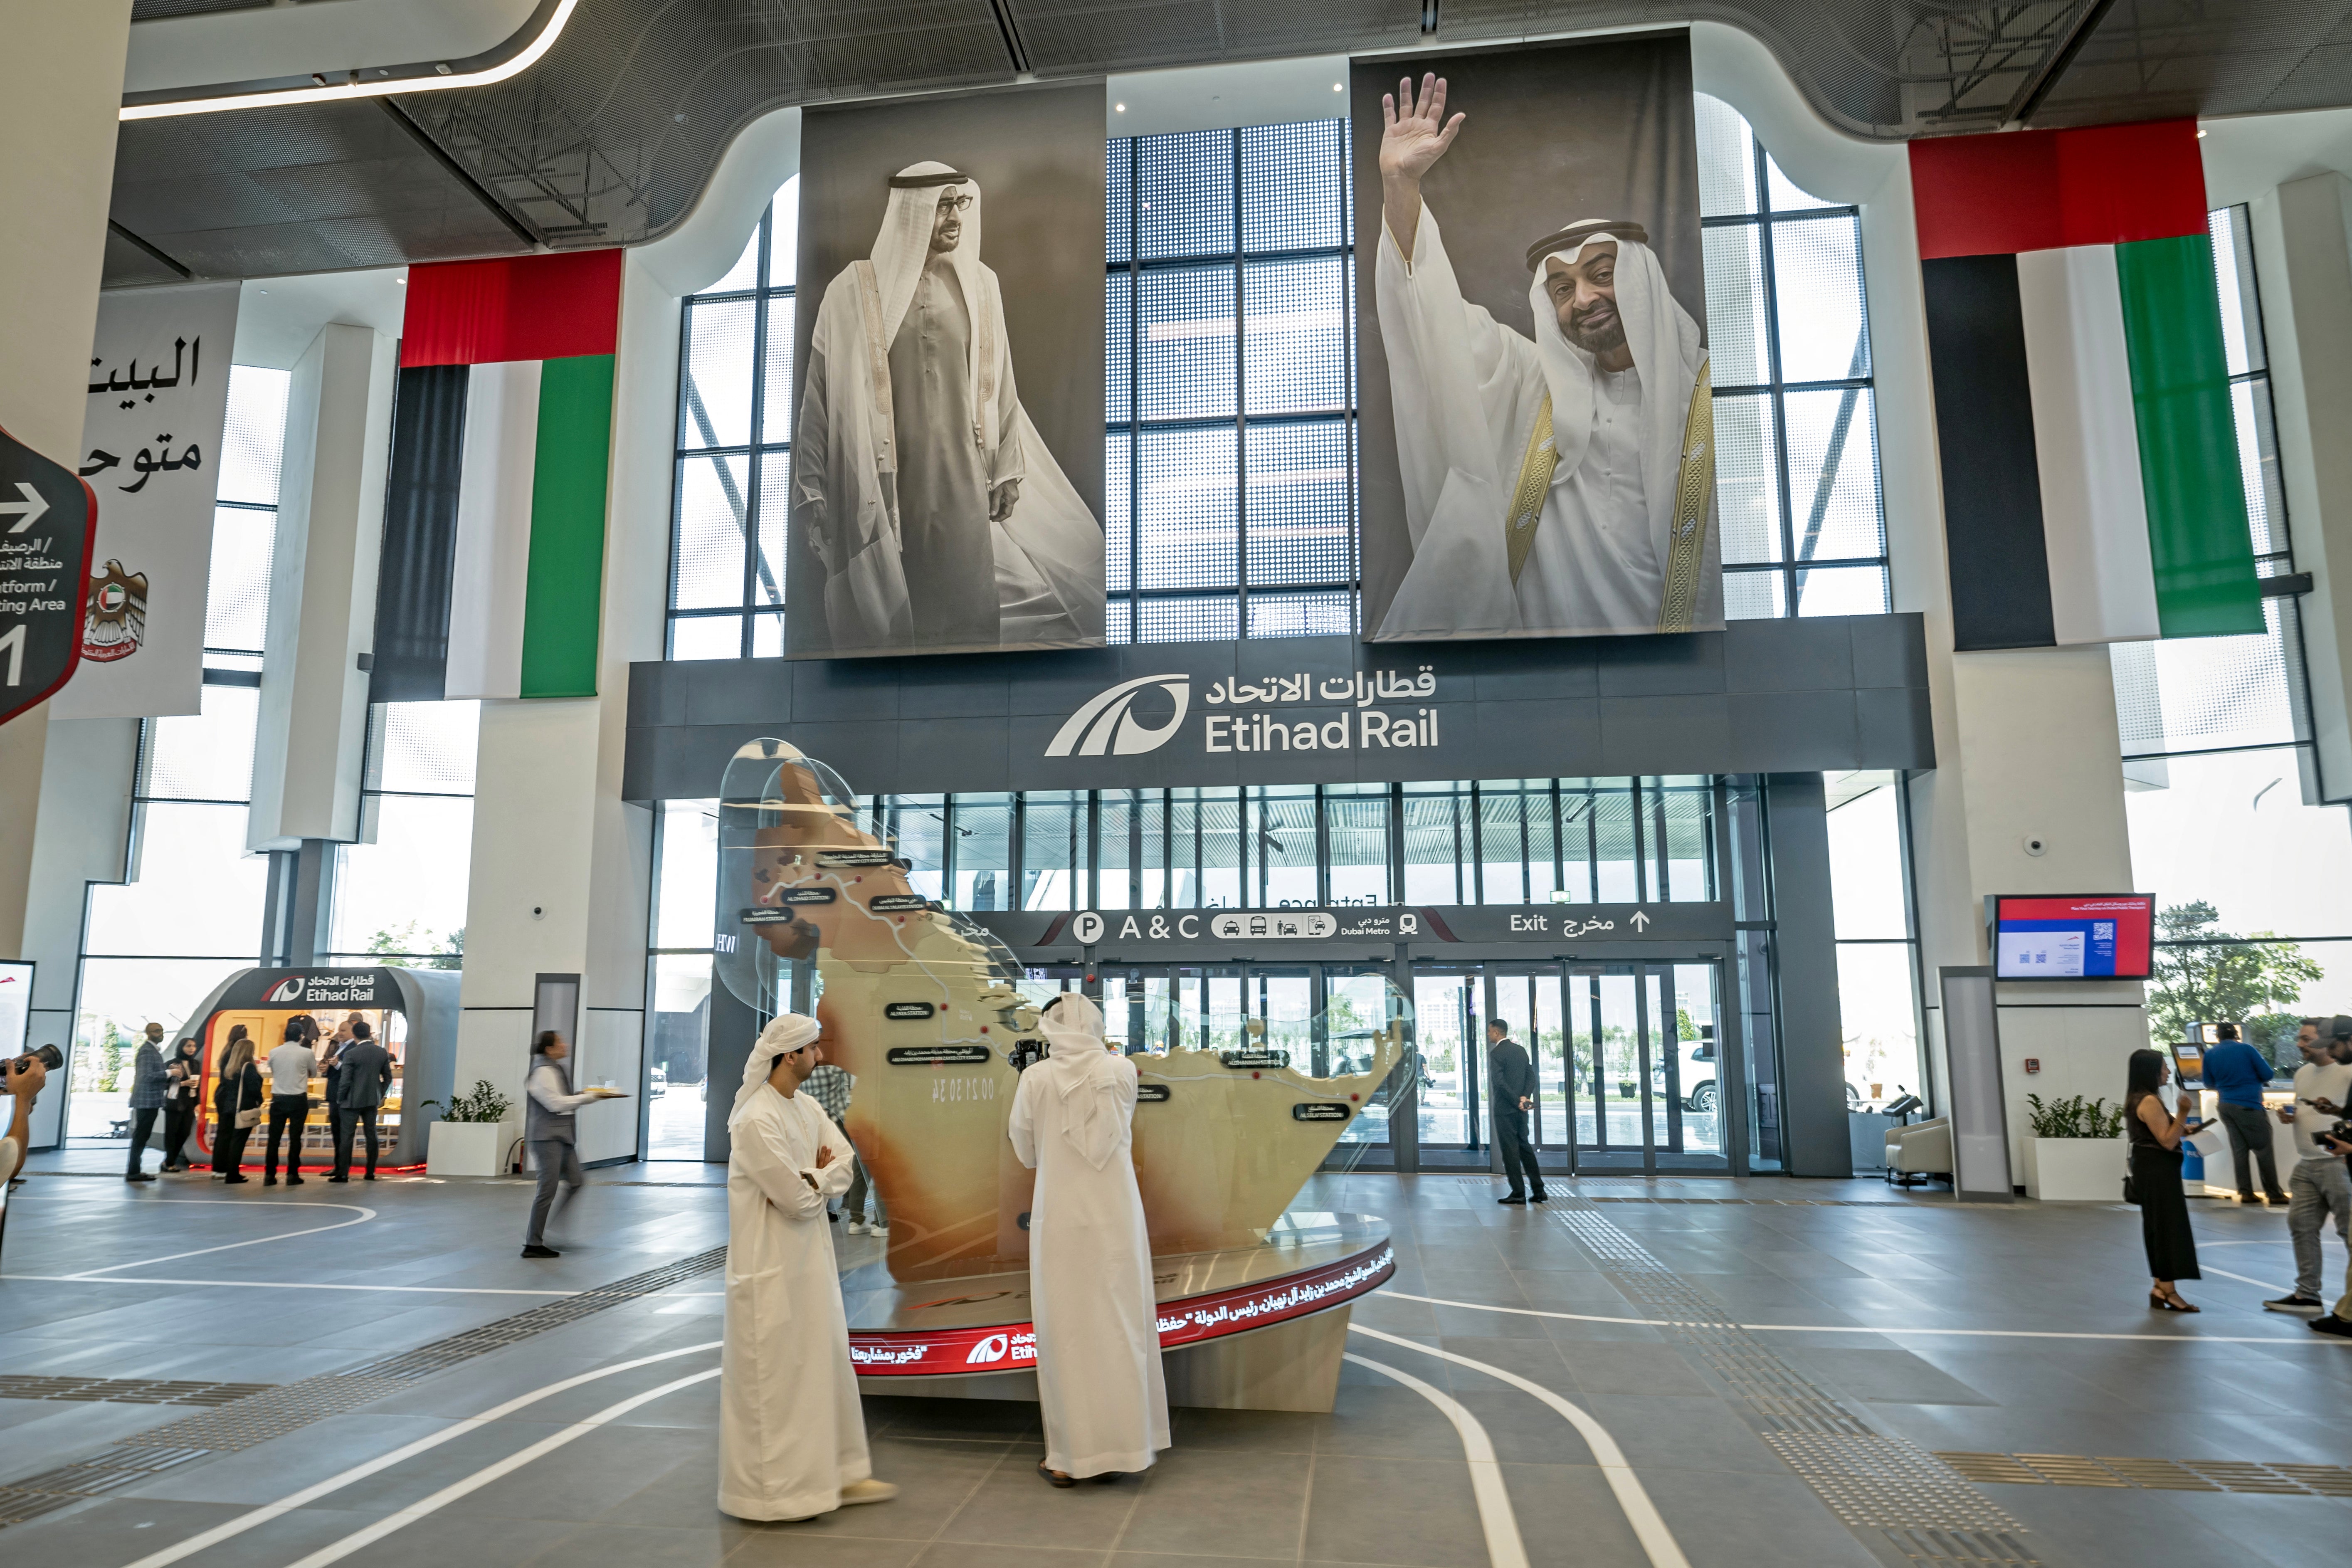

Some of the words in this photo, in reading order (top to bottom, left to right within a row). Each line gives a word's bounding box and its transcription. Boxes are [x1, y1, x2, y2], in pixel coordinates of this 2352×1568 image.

[79, 433, 201, 494] متوح
[24, 557, 63, 570] منطقة
[29, 598, 67, 611] Area
[1206, 673, 1311, 706] الاتحاد
[1320, 664, 1437, 707] قطارات
[1206, 711, 1350, 753] Etihad
[1361, 709, 1438, 749] Rail
[1119, 916, 1142, 938] A
[1149, 915, 1170, 939] &
[1178, 915, 1199, 939] C
[1358, 918, 1372, 928] دبي
[1373, 917, 1390, 926] مترو
[1510, 914, 1548, 931] Exit
[1564, 915, 1614, 938] مخرج
[308, 976, 339, 986] الاتحاد
[341, 974, 374, 988] قطارات
[306, 988, 349, 1001] Etihad
[350, 988, 374, 1001] Rail
[1325, 1278, 1345, 1292] محمد
[1345, 1267, 1362, 1289] الشيخ
[1287, 1287, 1299, 1306] آل
[1298, 1284, 1315, 1301] زايد
[1314, 1285, 1325, 1298] بن
[1195, 1306, 1229, 1327] الدولة
[1229, 1300, 1259, 1321] رئيس
[851, 1346, 896, 1364] بمشاريعنا
